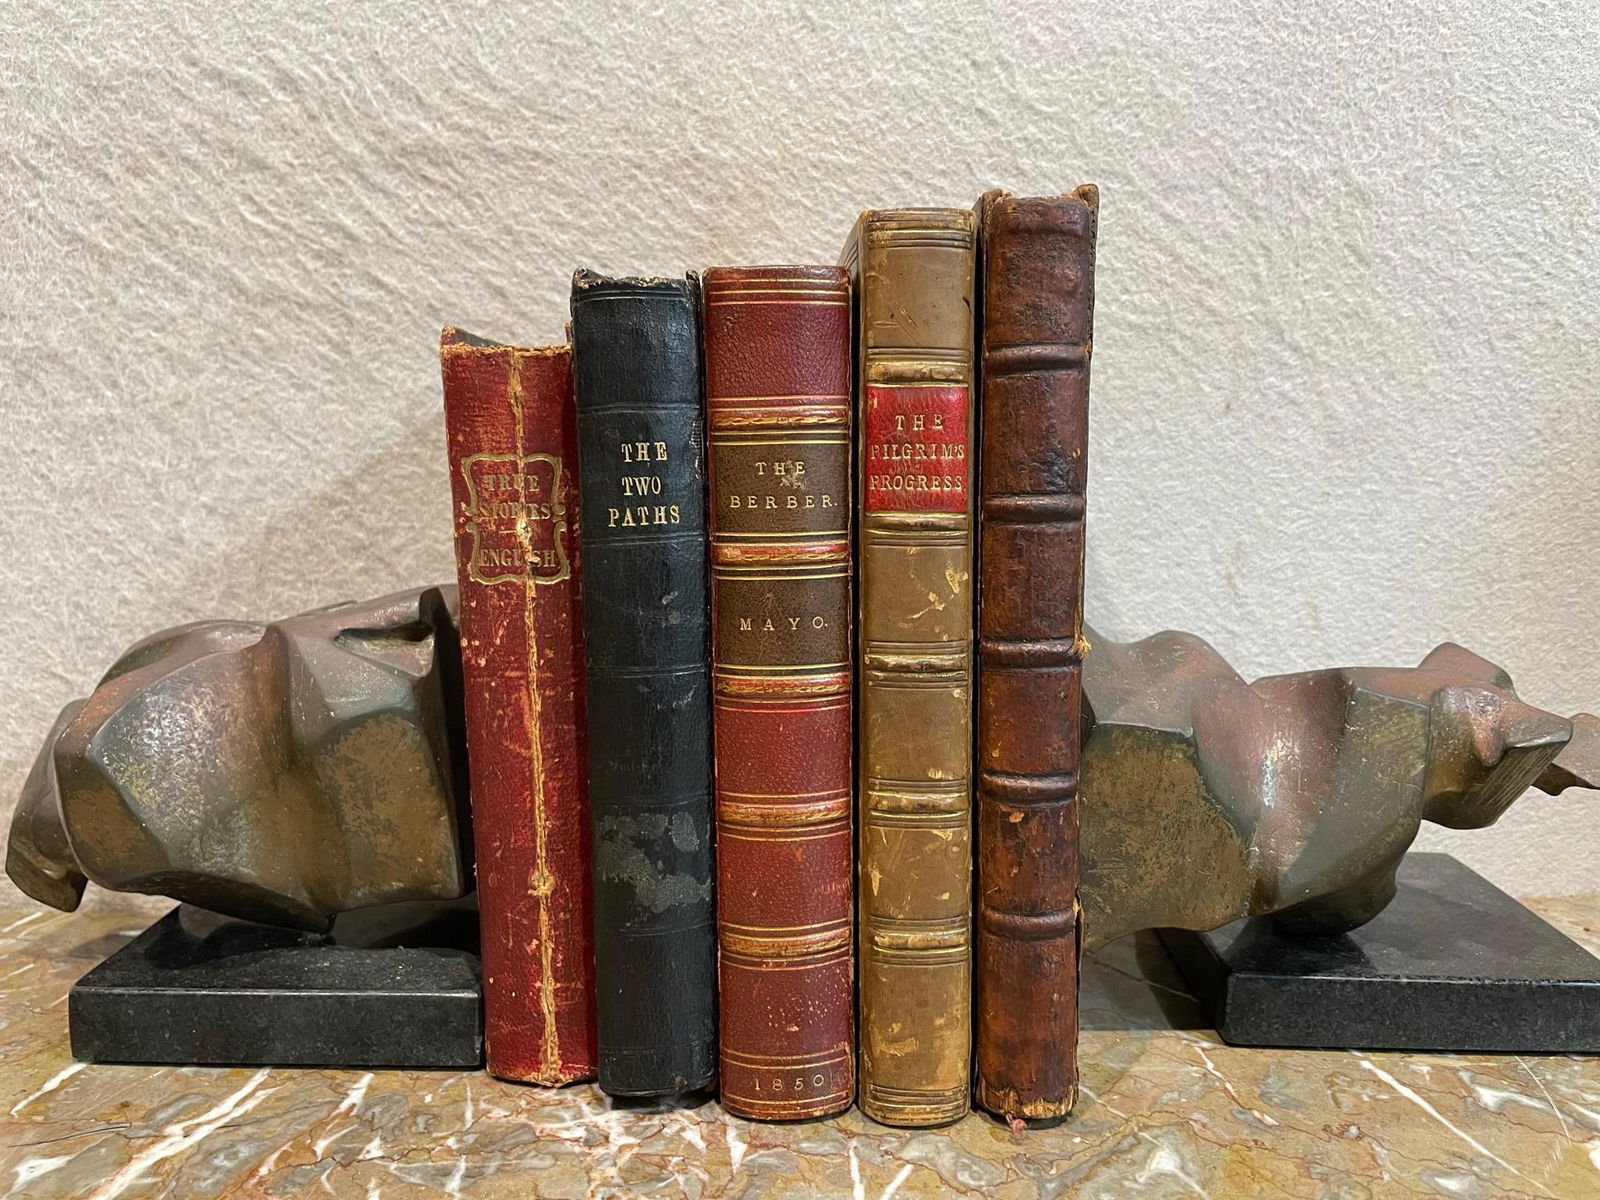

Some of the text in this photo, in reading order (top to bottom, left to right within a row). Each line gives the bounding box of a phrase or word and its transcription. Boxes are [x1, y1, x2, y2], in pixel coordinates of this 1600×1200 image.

[895, 414, 943, 431] THE
[621, 441, 668, 463] THE
[870, 443, 965, 460] PILGRIM'S
[755, 462, 806, 475] THE
[482, 474, 540, 492] TRUE
[621, 476, 662, 496] TWO
[730, 495, 838, 509] BERBER.
[608, 504, 681, 527] PATHS
[478, 549, 556, 568] ENGLSH
[740, 617, 828, 631] MAYO.
[754, 1074, 825, 1091] 1850
